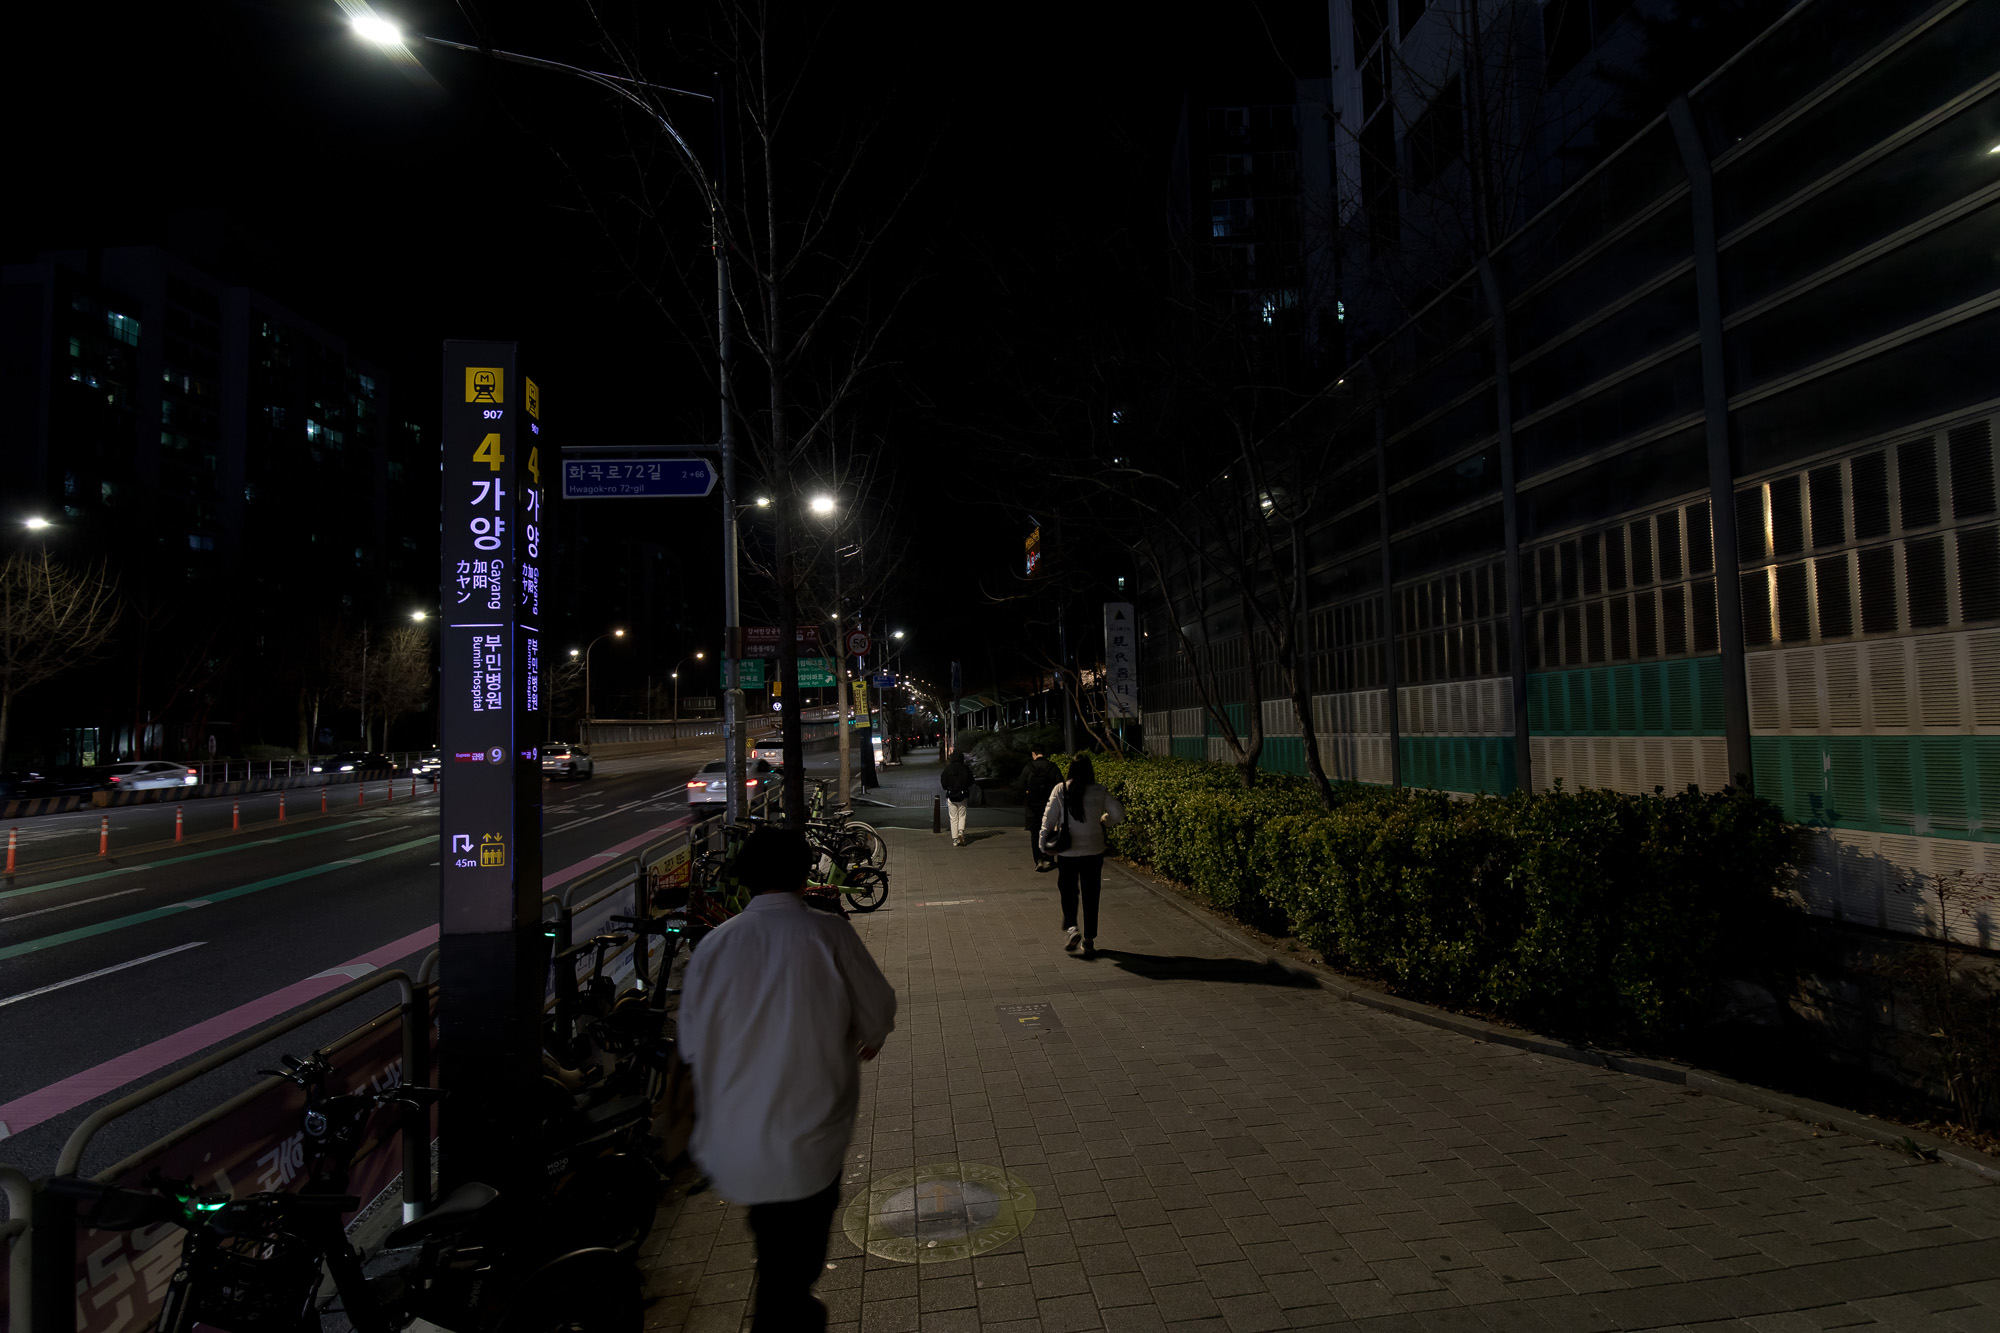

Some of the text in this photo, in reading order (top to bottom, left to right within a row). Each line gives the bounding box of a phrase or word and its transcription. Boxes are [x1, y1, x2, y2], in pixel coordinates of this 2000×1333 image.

[483, 410, 504, 420] 907
[472, 433, 505, 471] 4
[527, 446, 540, 484] 4
[569, 484, 645, 494] Hwagok-ro 72-gil
[470, 477, 506, 551] 가양
[456, 559, 471, 604] カヤン
[487, 559, 504, 610] Gayang
[471, 636, 484, 712] Bumin Hospital
[484, 634, 503, 710] 부민병원
[491, 748, 502, 762] 9
[455, 858, 477, 868] 45m
